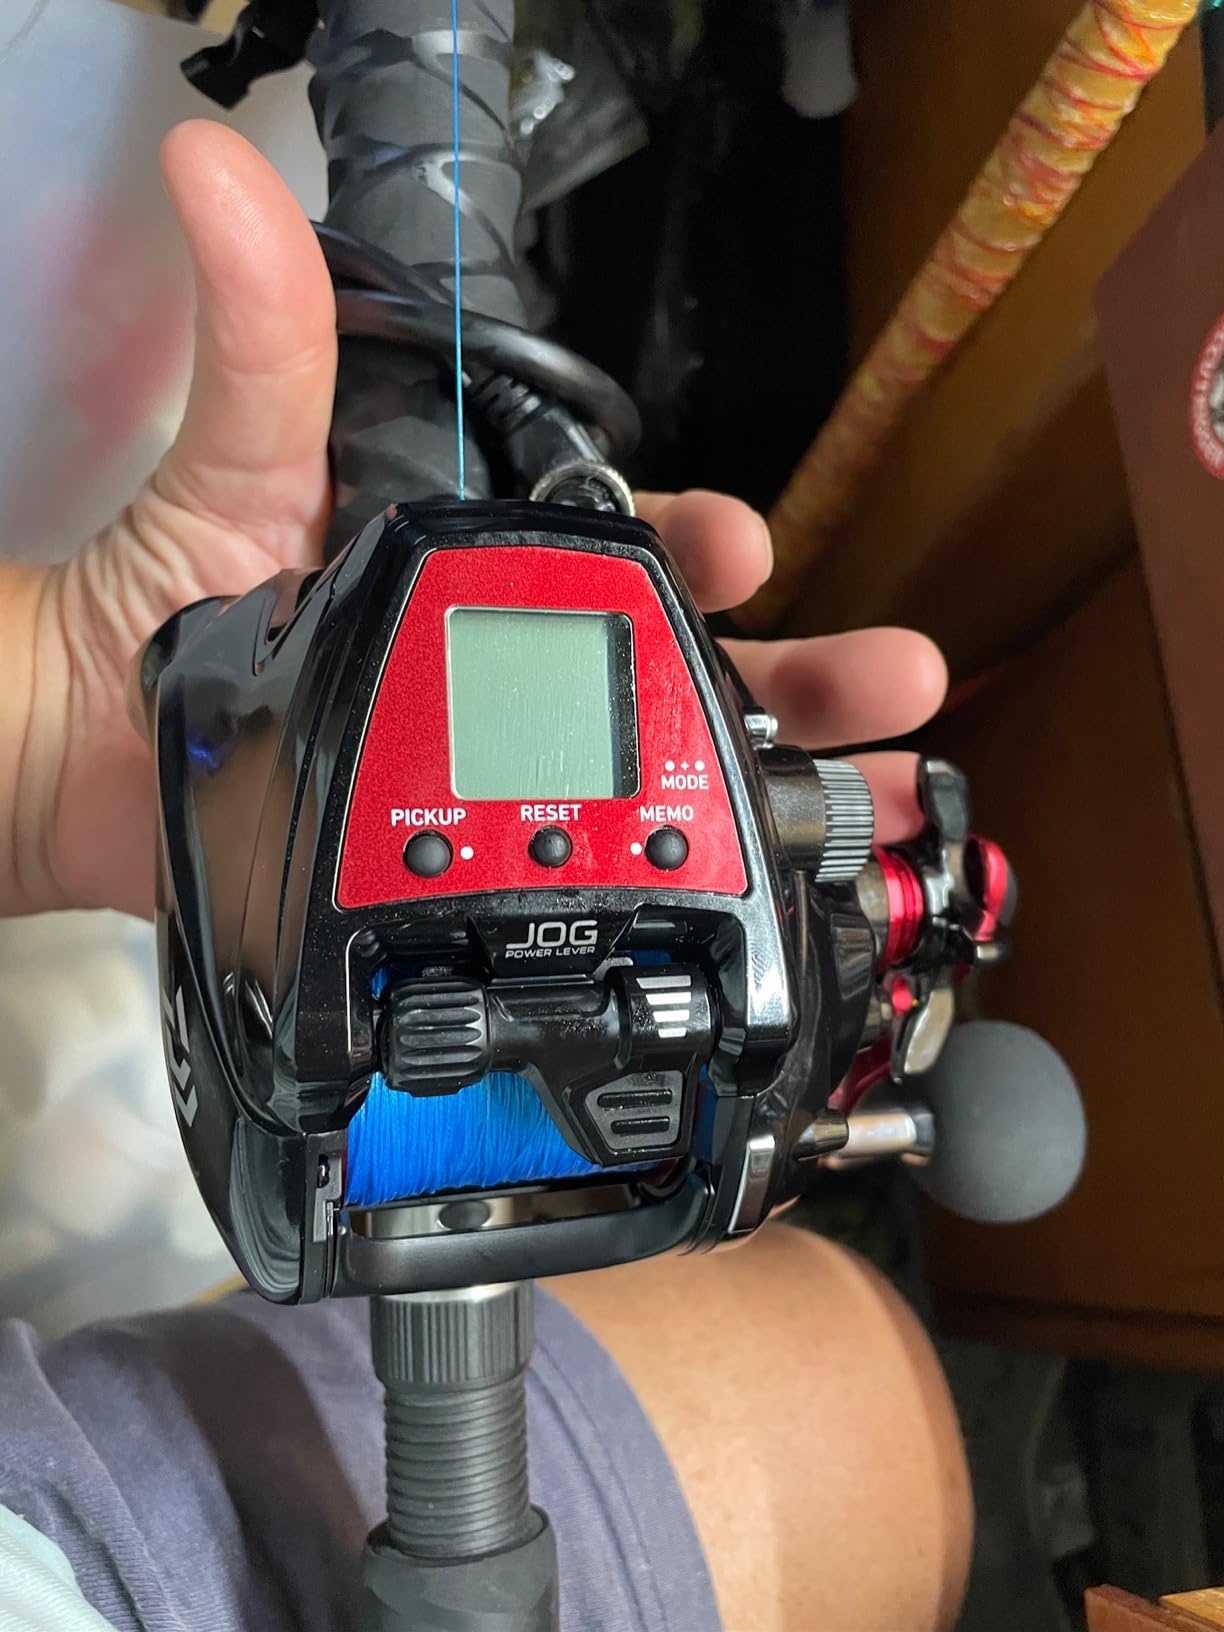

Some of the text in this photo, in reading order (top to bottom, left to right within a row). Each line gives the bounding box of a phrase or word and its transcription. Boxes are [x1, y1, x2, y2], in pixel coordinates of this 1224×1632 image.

[660, 774, 709, 790] MODE
[391, 807, 467, 827] PICKUP
[520, 804, 582, 822] RESET
[639, 805, 694, 822] MEMO
[506, 920, 598, 949] JOG
[505, 946, 596, 959] POWER LEVER
